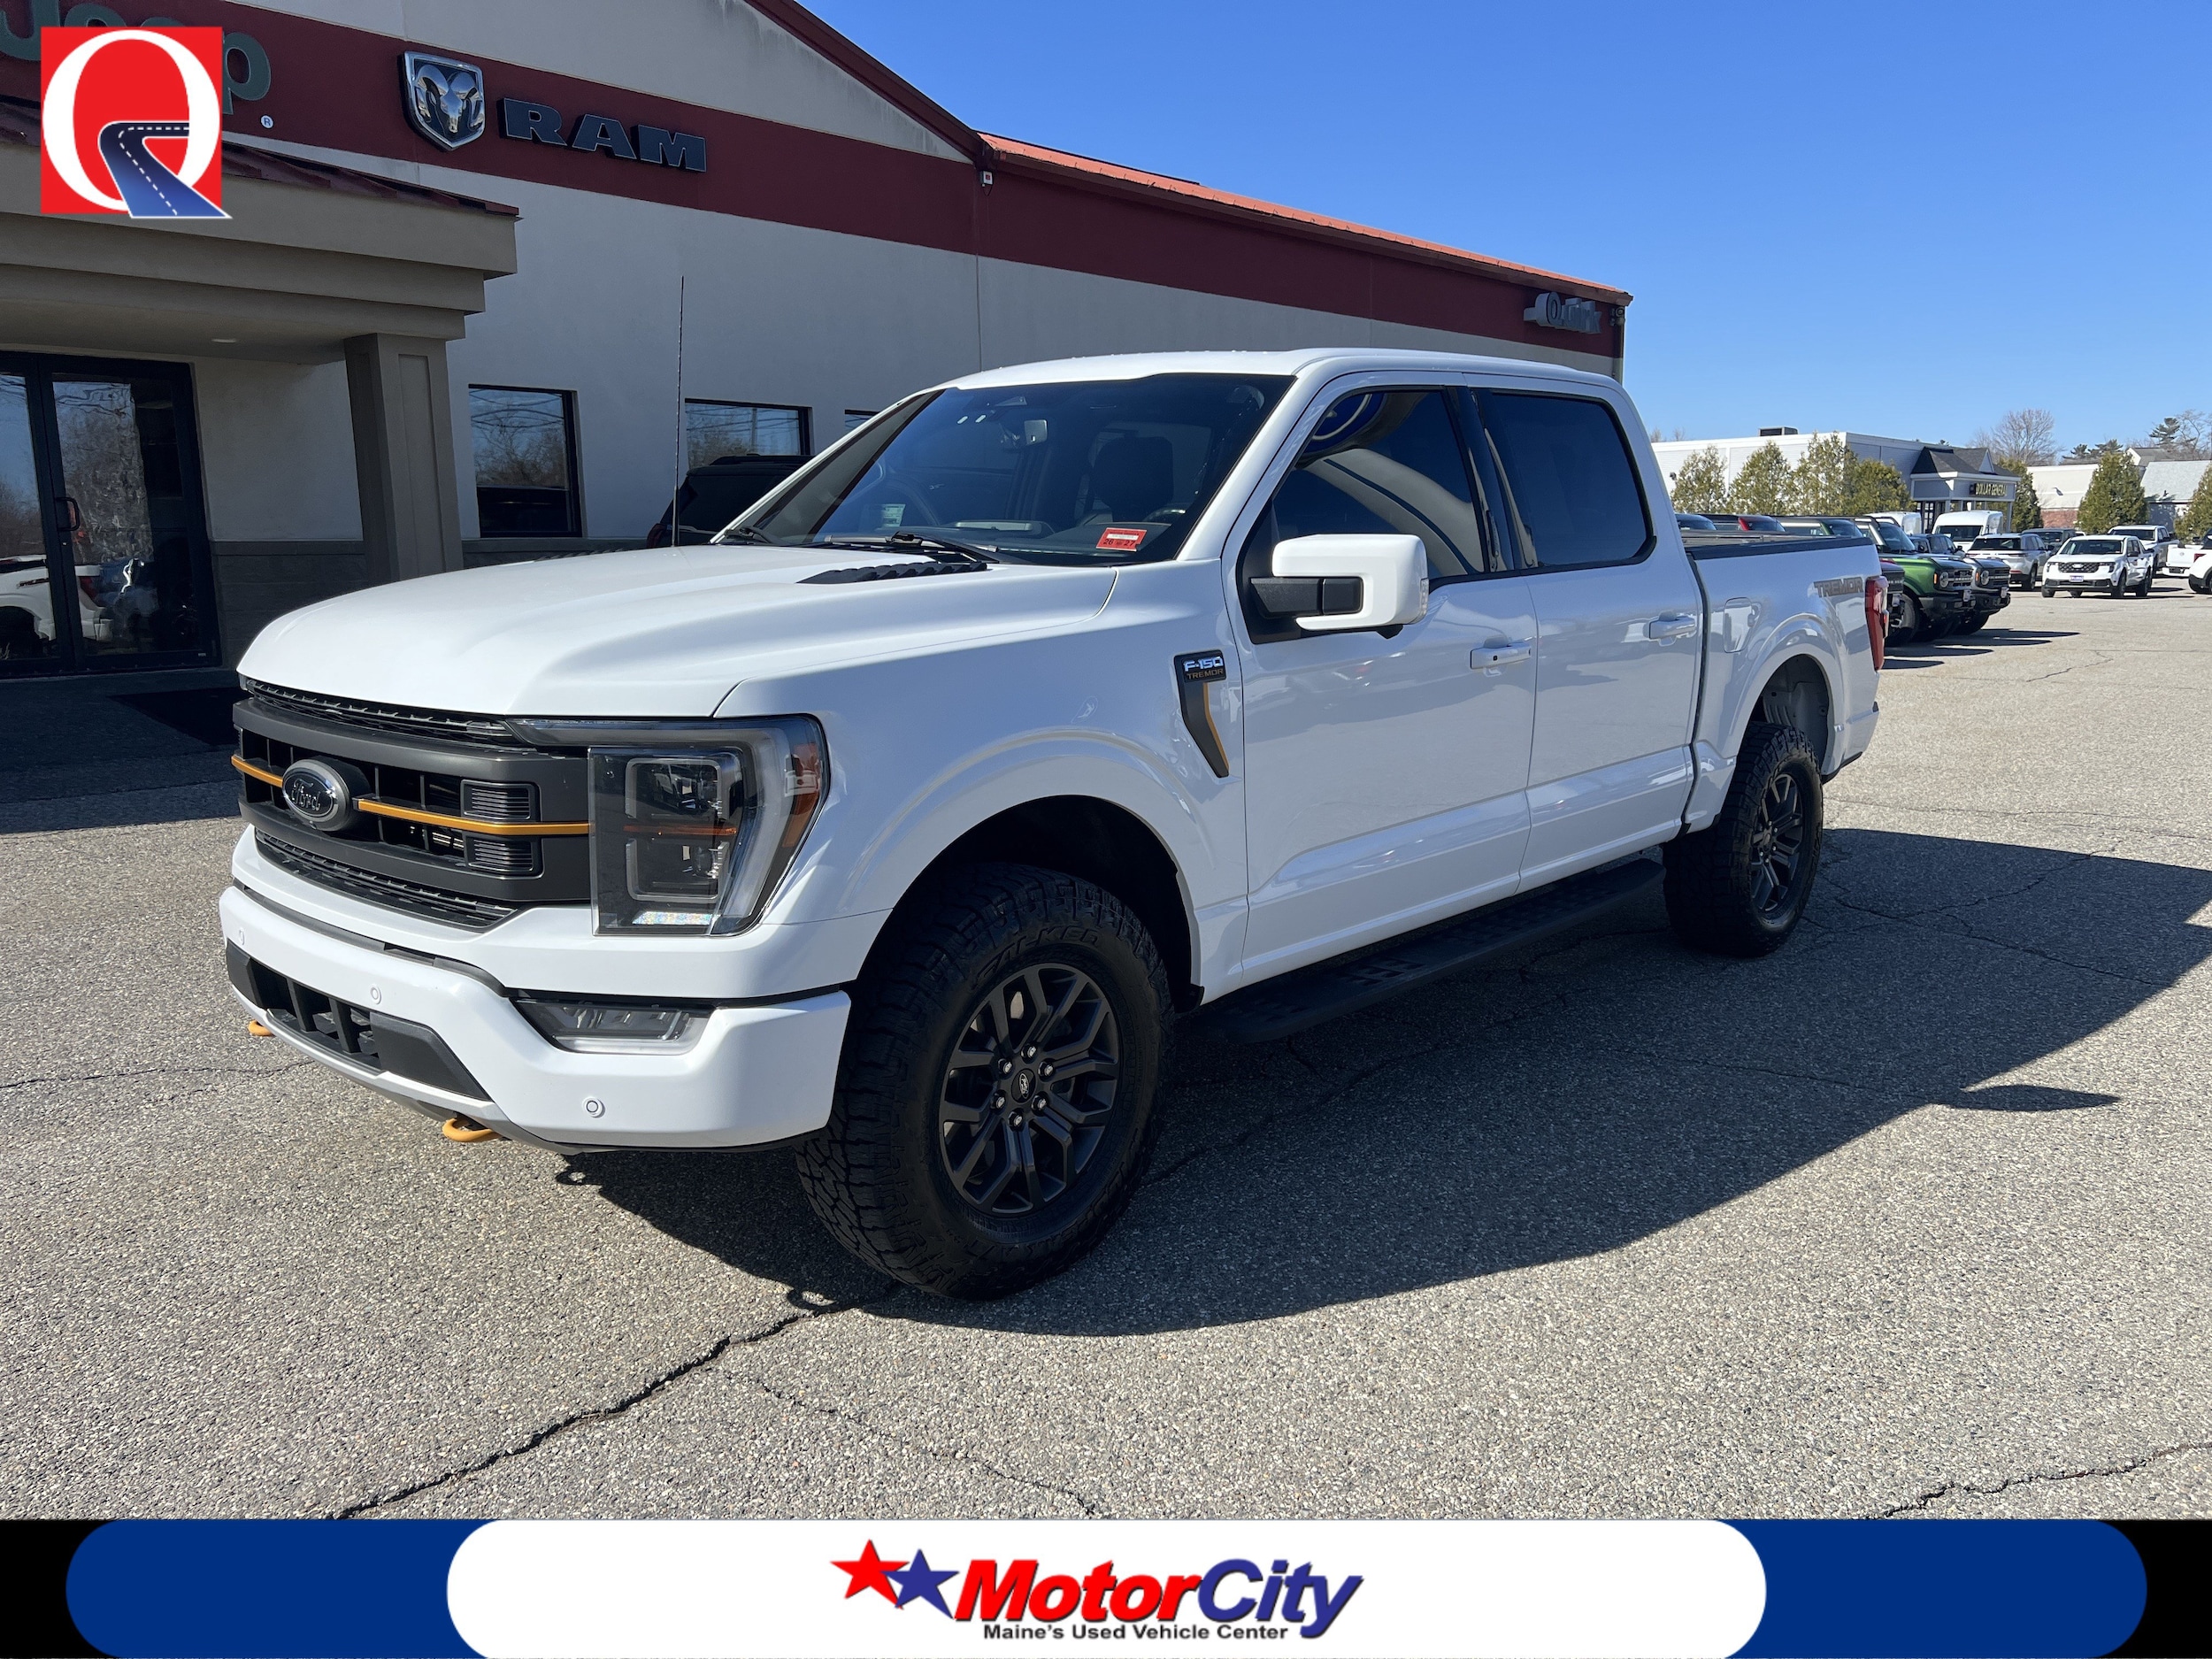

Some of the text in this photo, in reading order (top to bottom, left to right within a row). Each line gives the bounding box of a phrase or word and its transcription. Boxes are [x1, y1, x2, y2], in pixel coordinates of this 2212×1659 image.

[502, 97, 707, 173] RAM
[1813, 577, 1863, 598] TREMOR
[1183, 656, 1224, 672] F-150
[1186, 668, 1224, 680] TREMOR
[291, 778, 321, 811] Ford
